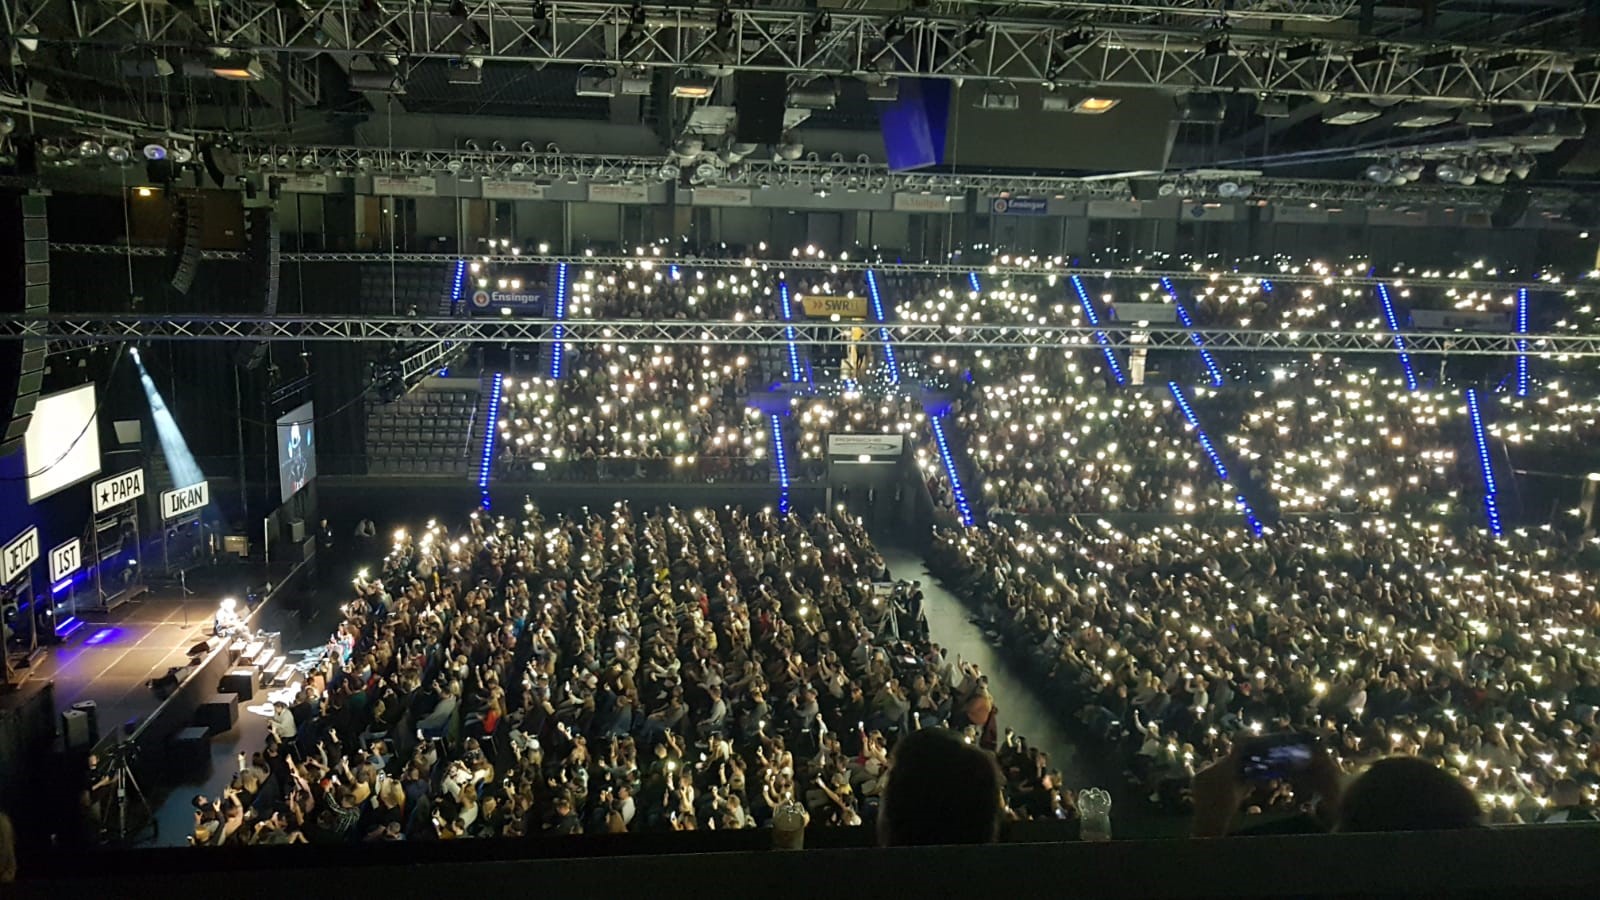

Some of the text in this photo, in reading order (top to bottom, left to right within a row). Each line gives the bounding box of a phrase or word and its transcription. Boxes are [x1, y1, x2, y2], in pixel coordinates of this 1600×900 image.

[491, 291, 540, 304] Ensinger
[111, 474, 141, 502] PAPA
[170, 486, 203, 513] DRAN
[9, 534, 34, 574] JETZT
[59, 545, 76, 575] IST
